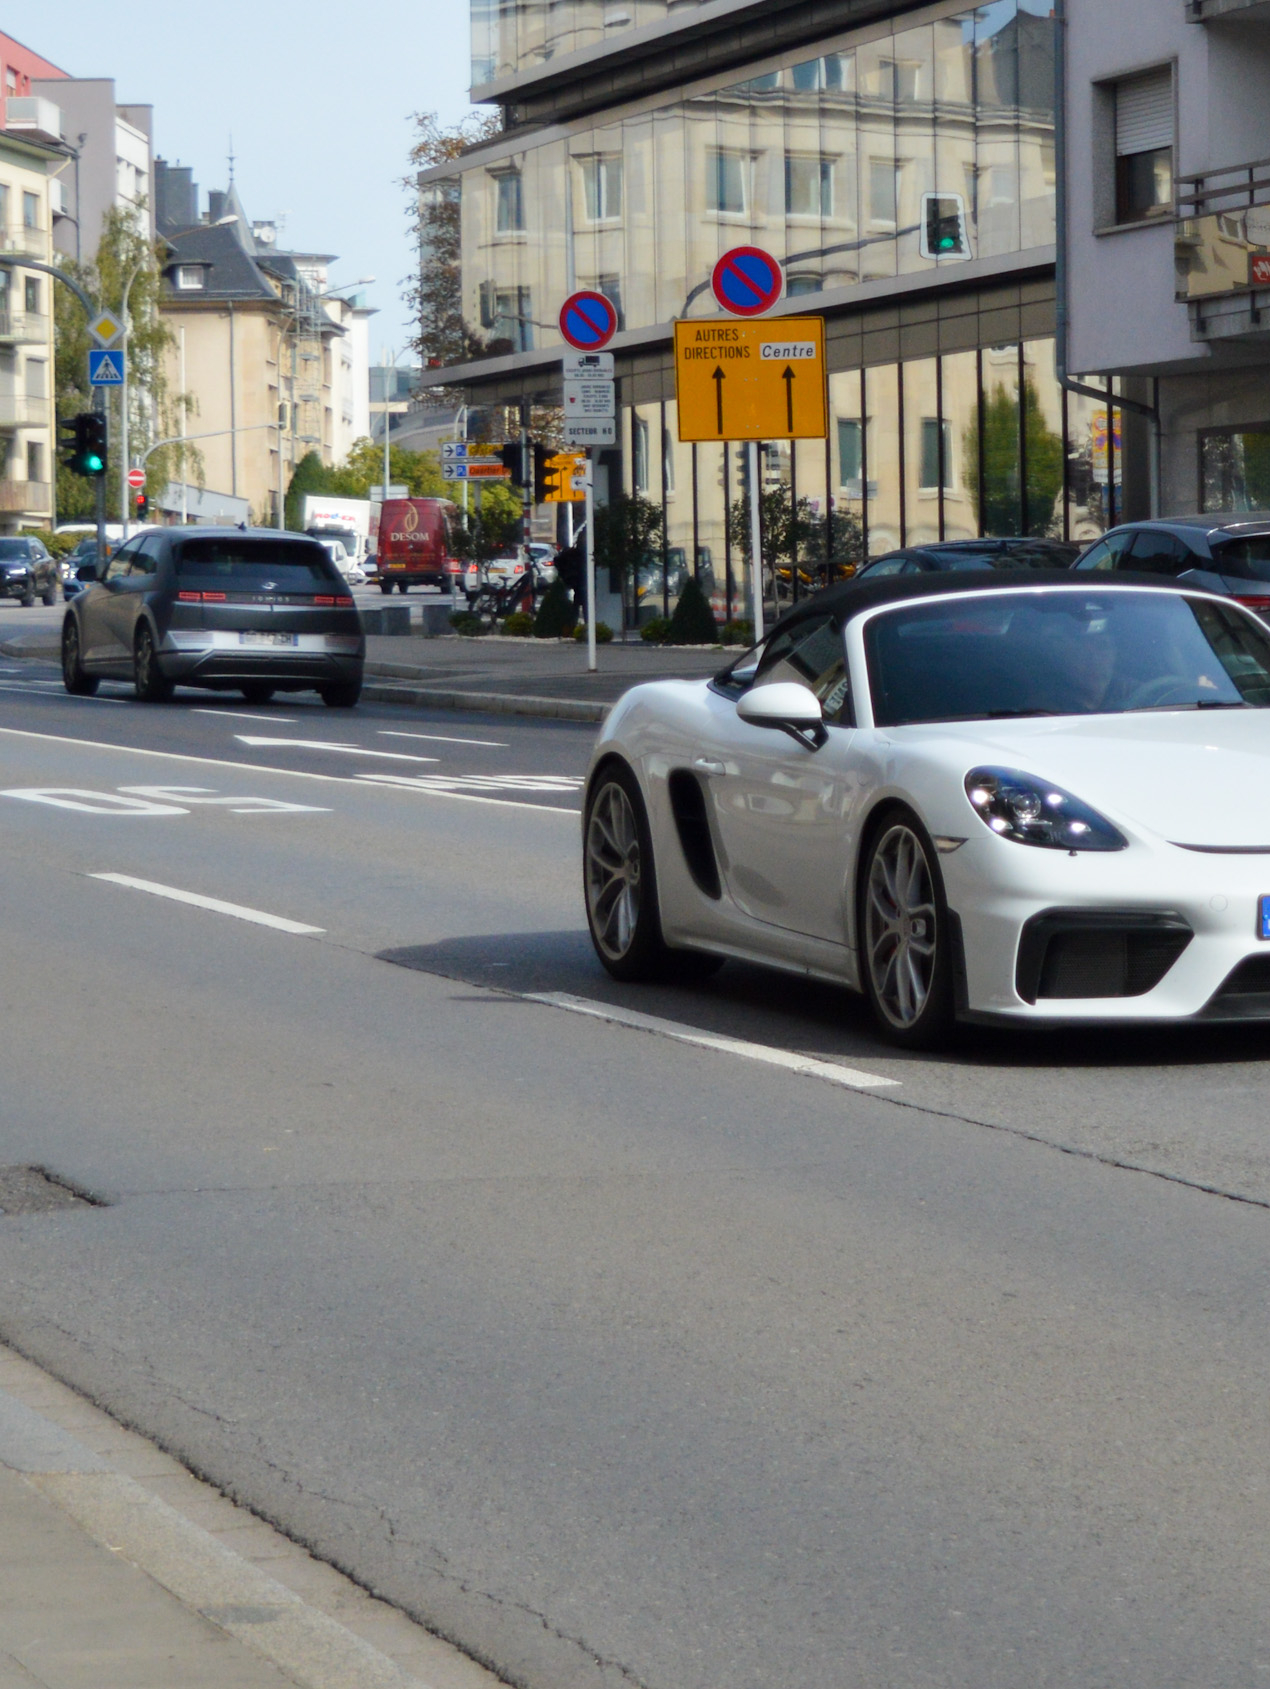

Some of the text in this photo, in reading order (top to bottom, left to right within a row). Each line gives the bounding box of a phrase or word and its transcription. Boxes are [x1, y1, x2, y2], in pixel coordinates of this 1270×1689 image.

[695, 328, 739, 342] AUTRES
[684, 346, 750, 360] DIRECTIONS
[762, 345, 814, 358] Centre
[568, 427, 598, 435] SECTEUR
[390, 532, 430, 542] DESOM
